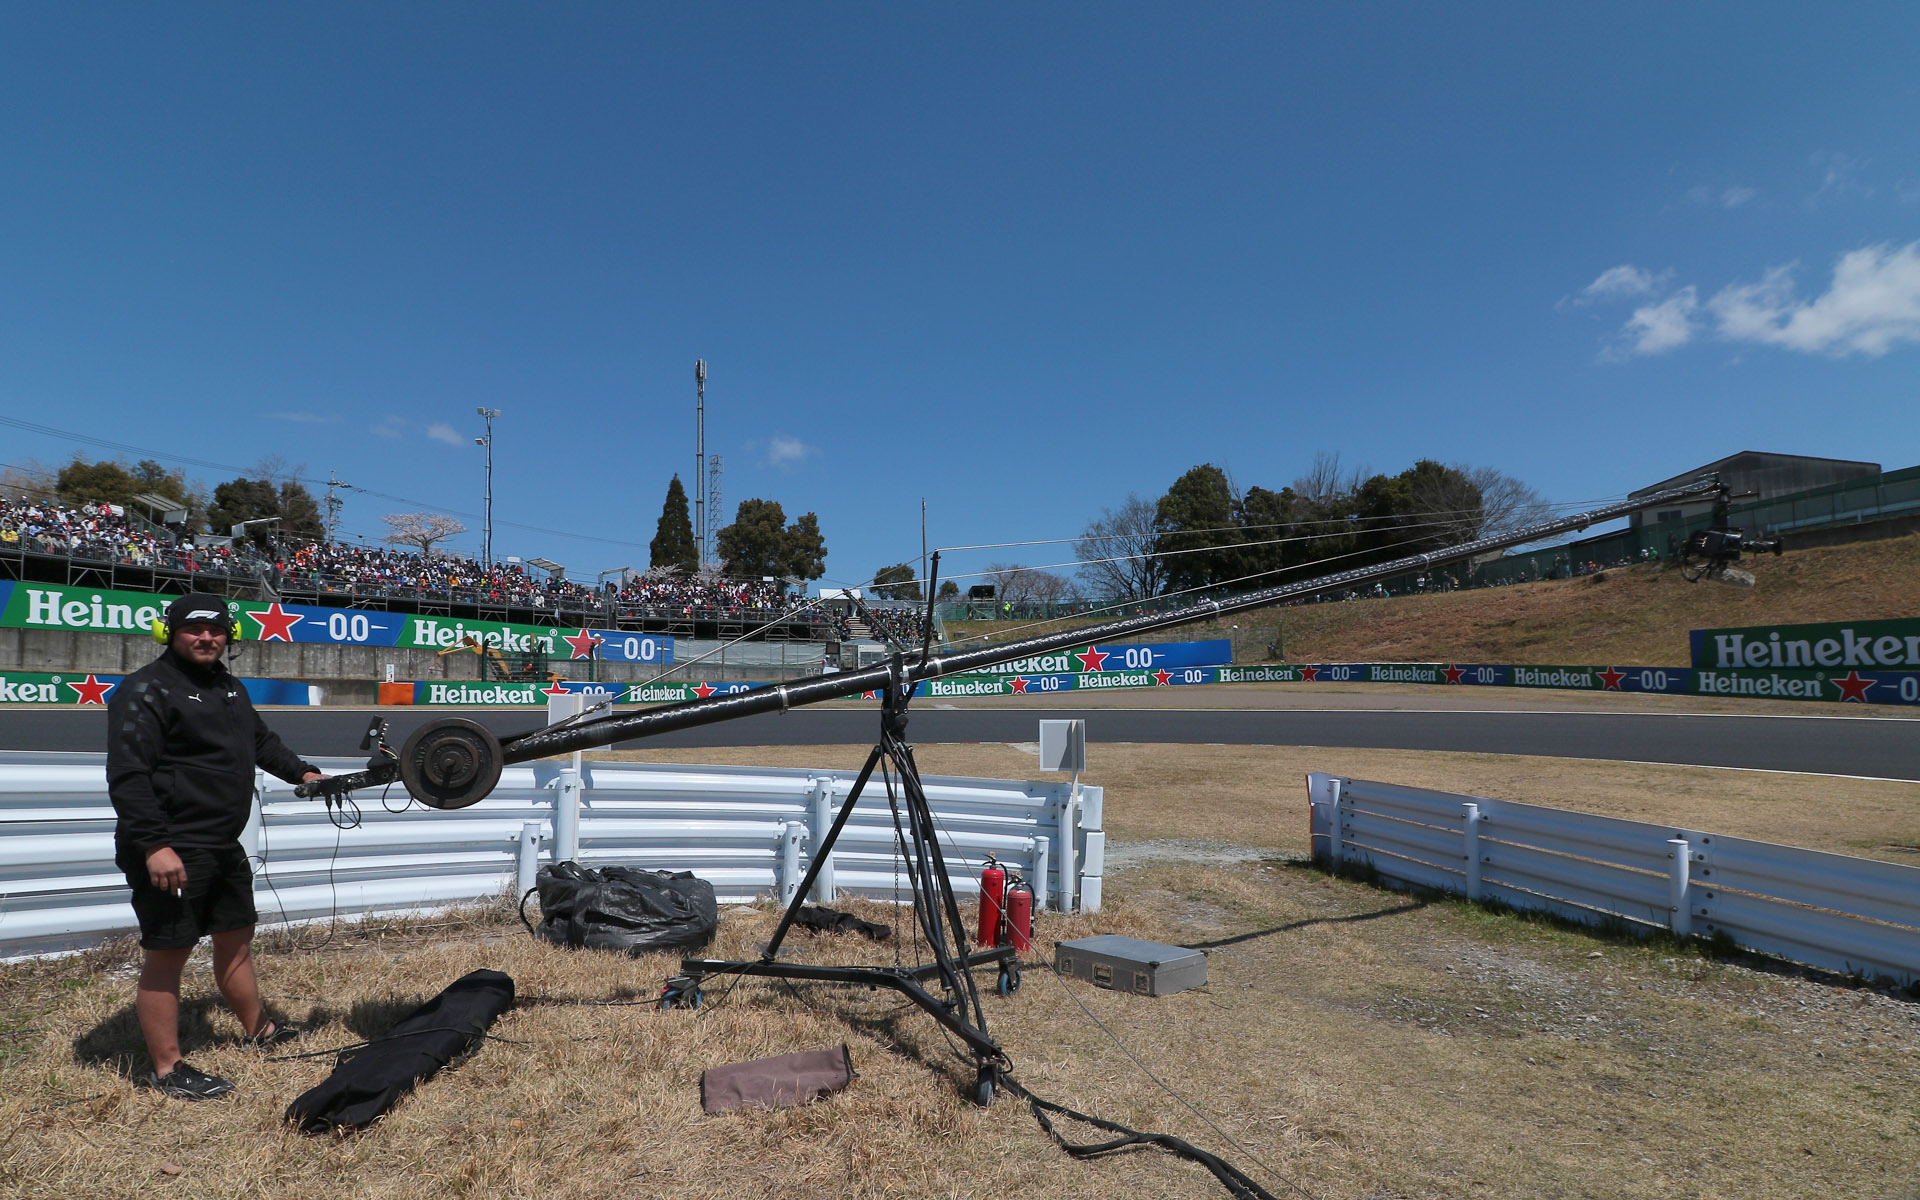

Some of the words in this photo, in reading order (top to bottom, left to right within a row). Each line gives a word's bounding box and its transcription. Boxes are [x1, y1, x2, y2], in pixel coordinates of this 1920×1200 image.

[26, 588, 173, 630] Heine
[329, 613, 369, 642] 0.0
[623, 637, 655, 660] 0.0
[962, 654, 1070, 675] neken
[1126, 648, 1152, 668] 0.0
[1078, 671, 1149, 688] Heineken
[1184, 670, 1203, 683] 0.0
[1219, 667, 1294, 682] Heineken
[1331, 666, 1350, 681] 0.0
[1371, 666, 1437, 682] Heineken
[1477, 667, 1495, 683] 0.0
[1514, 667, 1593, 687] Heineken
[1641, 670, 1667, 690] 0.0
[931, 680, 1003, 695] Heineken
[1041, 676, 1059, 690] 0.0
[1698, 672, 1824, 697] Heineken
[429, 684, 536, 704] Heineken
[629, 685, 687, 702] Heineken
